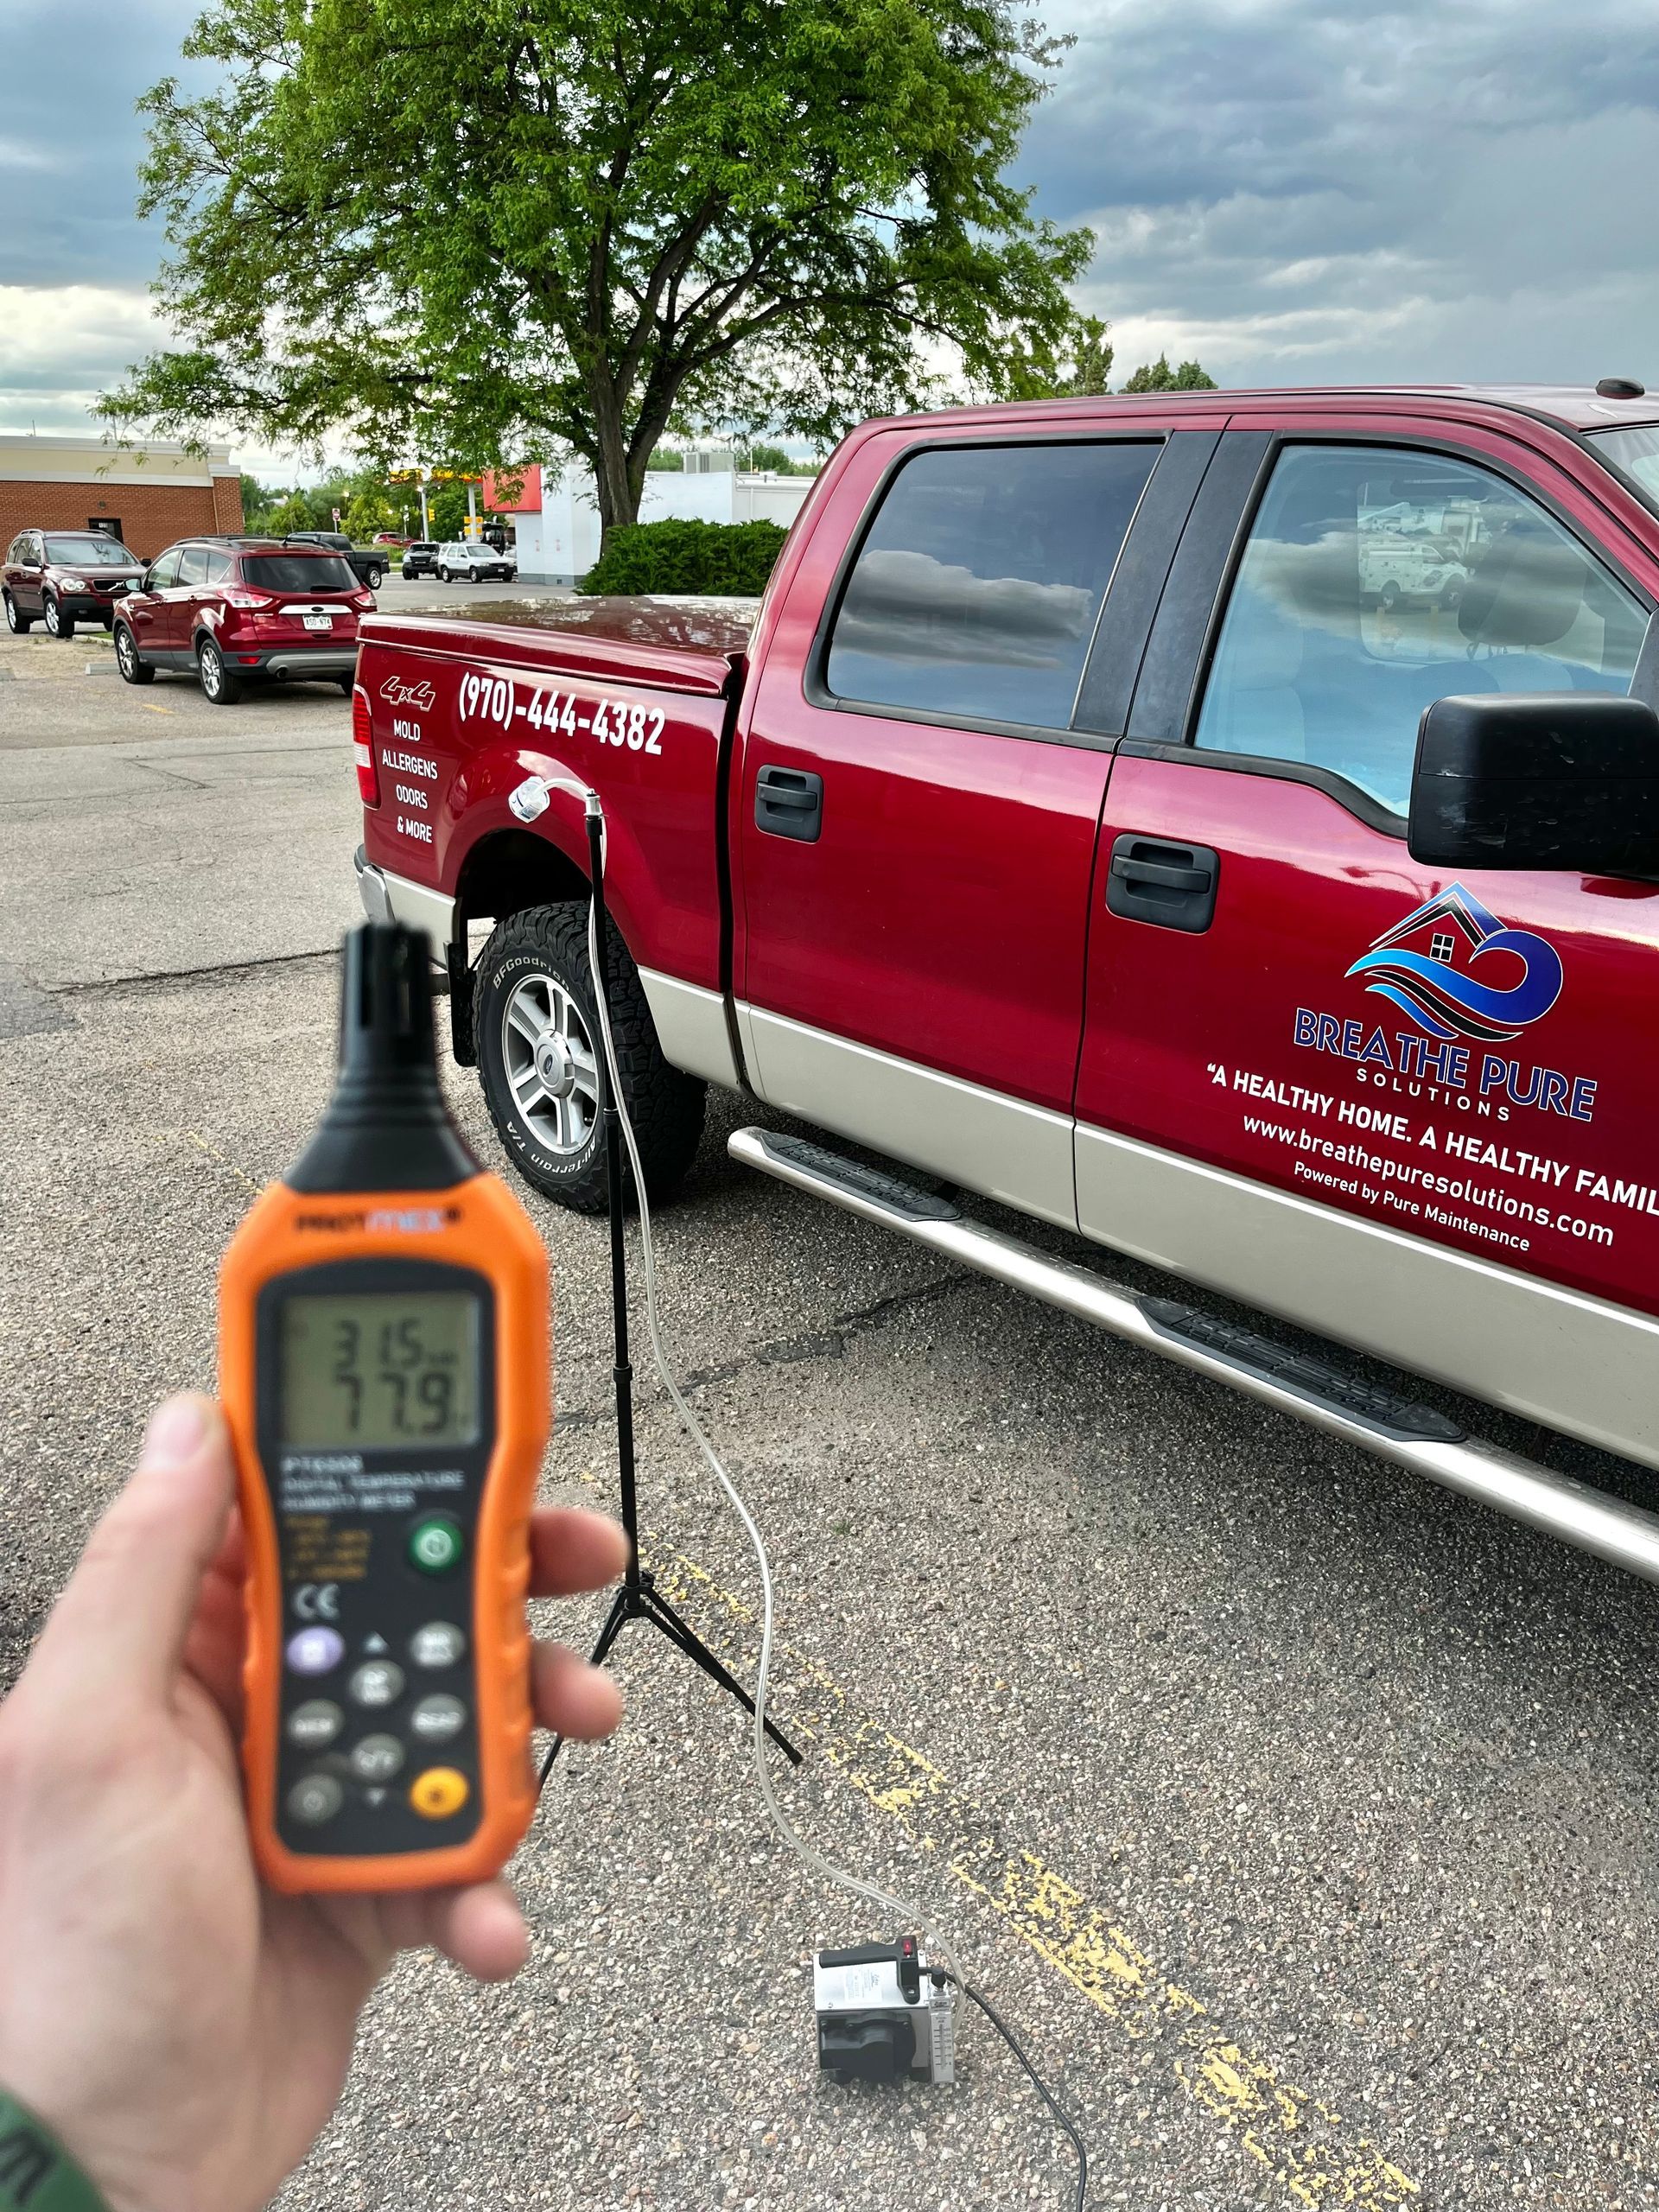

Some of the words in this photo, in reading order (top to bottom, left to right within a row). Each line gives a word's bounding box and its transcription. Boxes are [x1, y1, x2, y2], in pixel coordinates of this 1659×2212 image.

[380, 676, 435, 712] 4x4
[460, 672, 665, 755] (970)-444-4382
[393, 719, 422, 741] MOLD
[382, 749, 438, 780] ALLERGENS
[396, 785, 429, 810] ODORS
[397, 816, 404, 833] &
[405, 818, 433, 844] MORE
[493, 957, 569, 992] BFGoodrich
[1294, 1007, 1471, 1090] BREATHE
[1479, 1053, 1598, 1122] PURE
[1357, 1068, 1510, 1122] SOLUTIONS
[1233, 1069, 1334, 1117] HEALTHY
[1338, 1102, 1412, 1143] HOME.
[1419, 1126, 1437, 1150] A
[1445, 1132, 1571, 1187] HEALTHY
[531, 1135, 596, 1174] All-Terrain
[1243, 1115, 1614, 1247] www.breathepuresolutions.com
[1294, 1161, 1357, 1196] Powered
[1362, 1181, 1380, 1205] by
[1383, 1191, 1420, 1216] Pure
[1424, 1206, 1530, 1252] Maintenance
